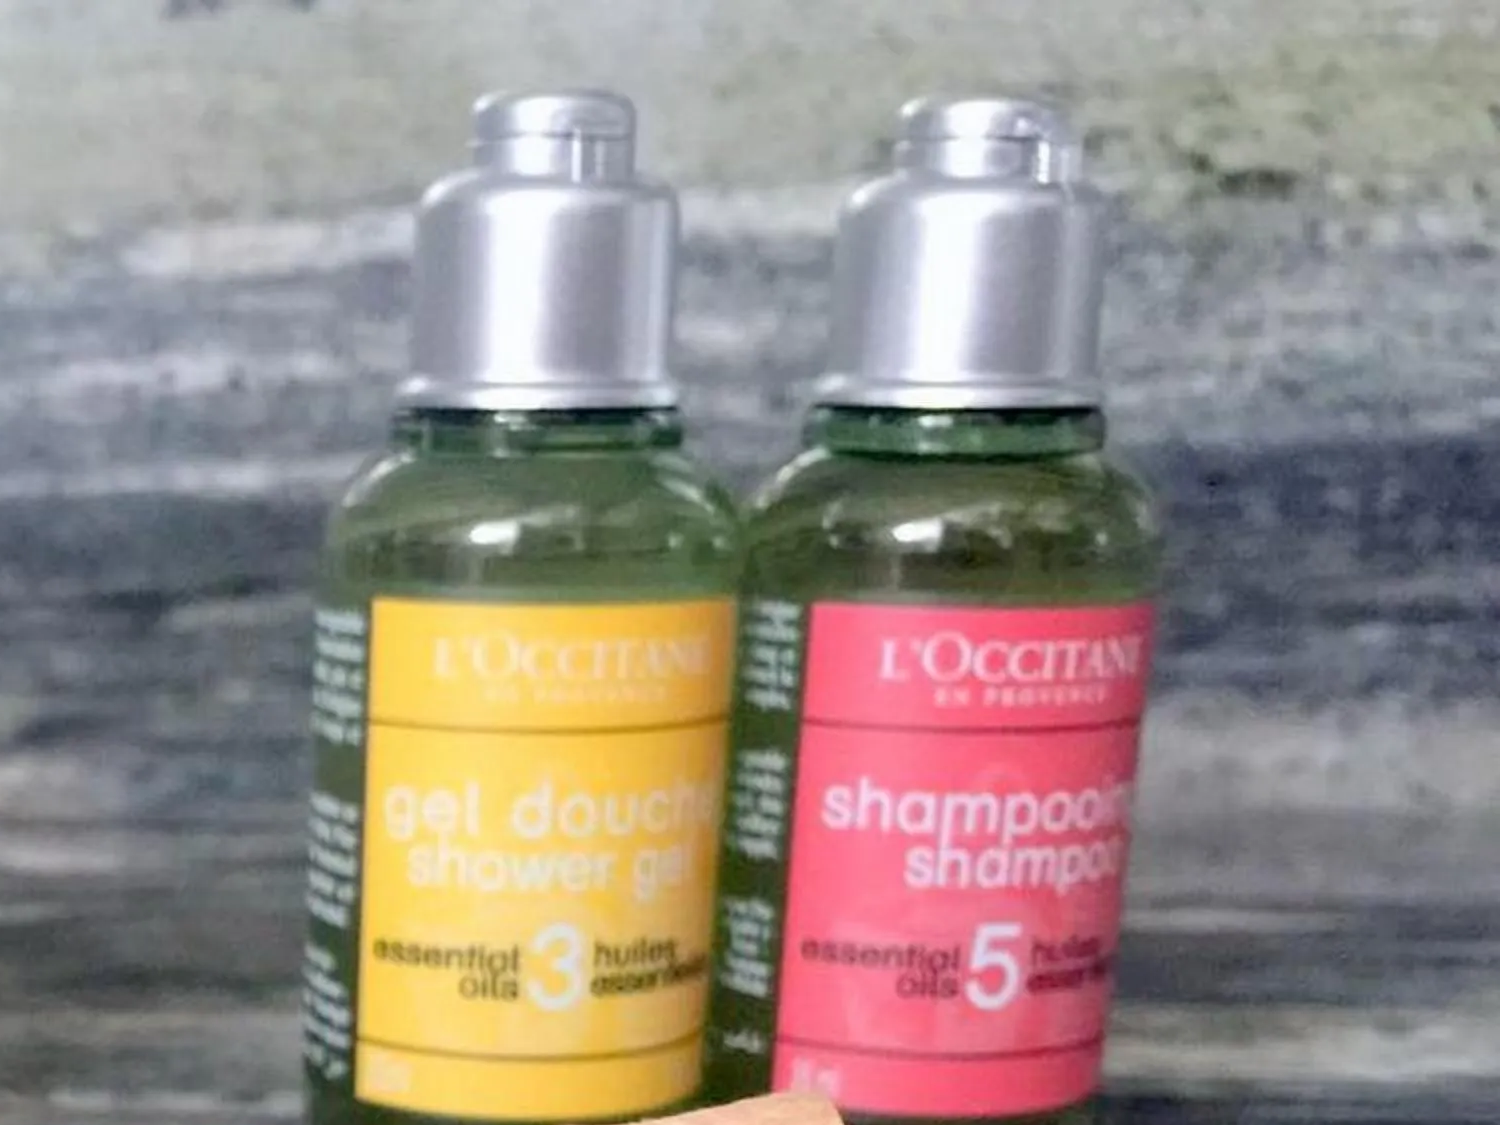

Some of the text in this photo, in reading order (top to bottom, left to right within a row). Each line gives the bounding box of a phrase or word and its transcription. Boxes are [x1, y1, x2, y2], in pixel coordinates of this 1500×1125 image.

[880, 630, 1143, 684] L'OCCITAN
[384, 781, 480, 842] gel
[407, 838, 618, 892] shower
[373, 937, 520, 972] essential
[525, 924, 584, 1012] 3
[802, 938, 961, 974] essential
[964, 921, 1022, 1012] 5
[457, 967, 519, 1001] oils
